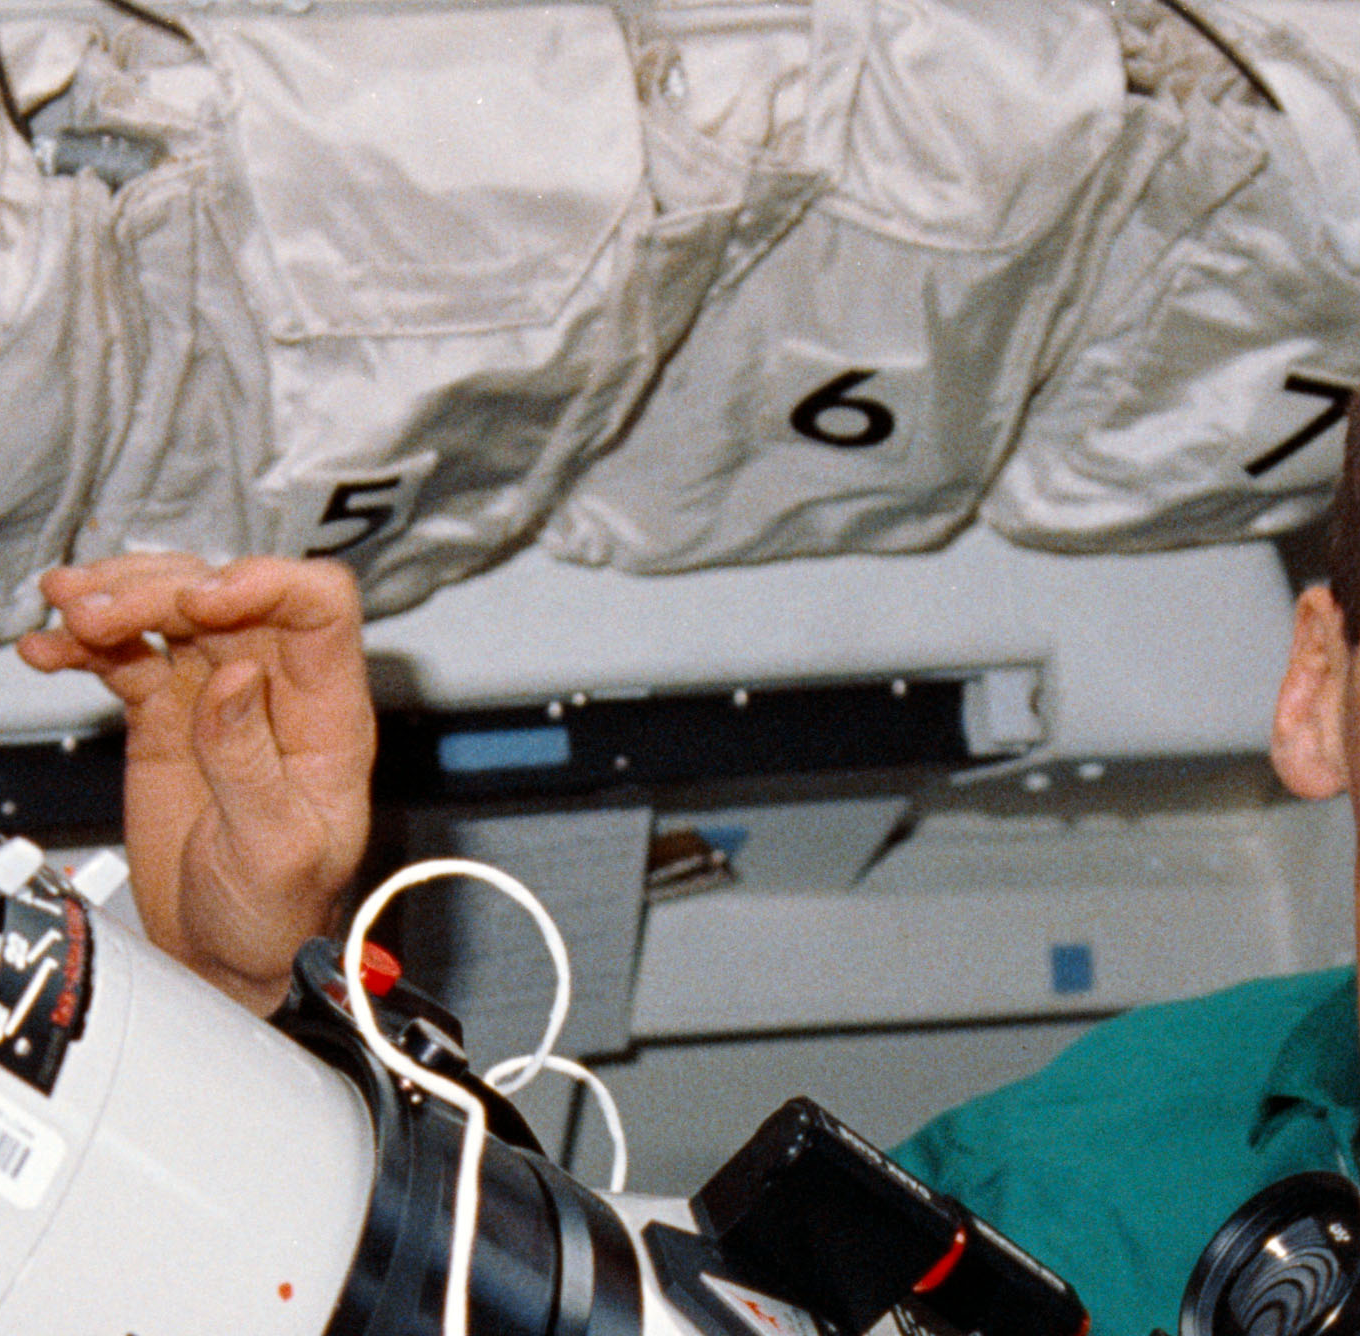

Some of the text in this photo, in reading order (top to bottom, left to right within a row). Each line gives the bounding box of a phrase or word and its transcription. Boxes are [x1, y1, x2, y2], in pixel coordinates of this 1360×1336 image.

[791, 369, 895, 448] 6
[1245, 374, 1353, 477] 7
[305, 476, 401, 560] 5
